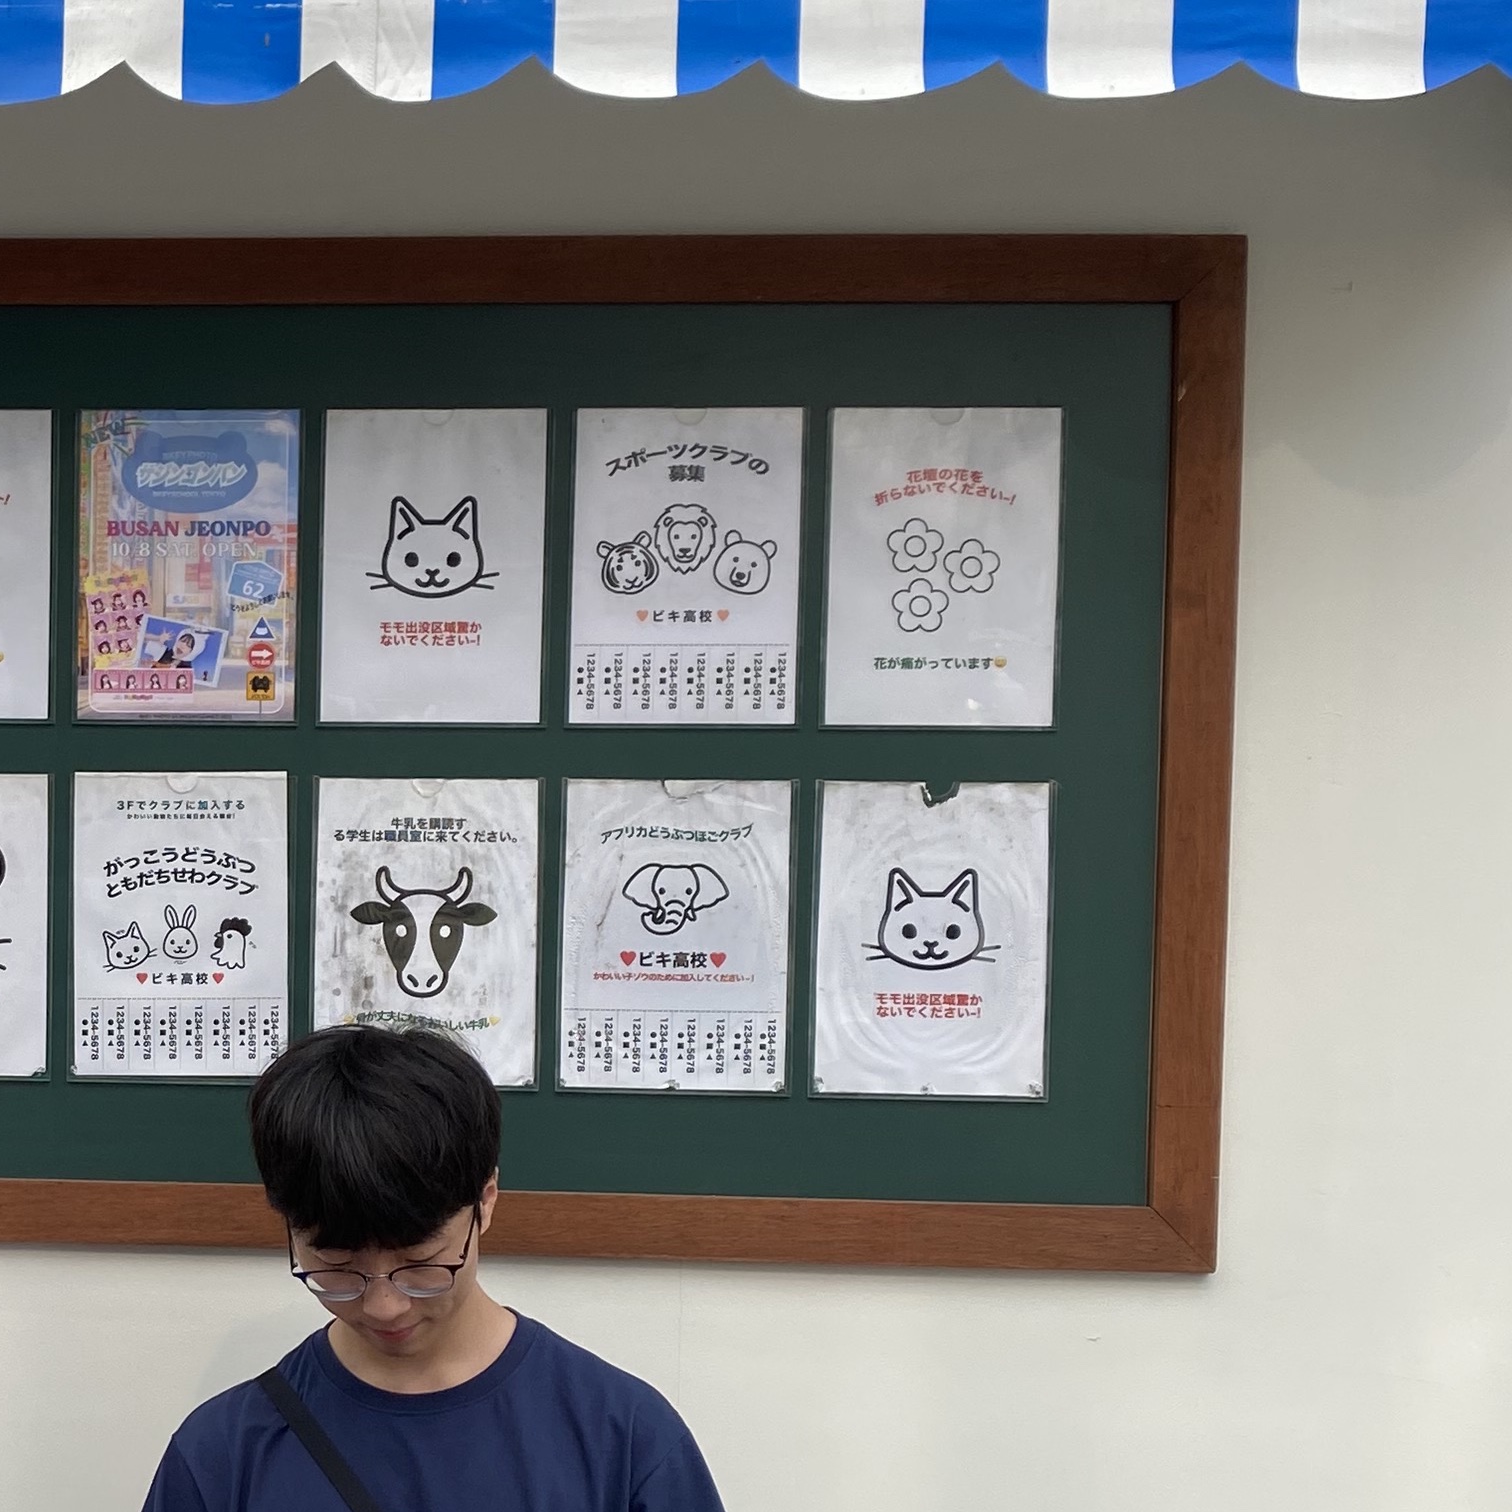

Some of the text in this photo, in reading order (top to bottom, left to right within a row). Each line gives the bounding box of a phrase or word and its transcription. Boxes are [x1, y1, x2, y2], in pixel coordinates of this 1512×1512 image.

[605, 443, 770, 477] スポーツクラブの
[668, 465, 705, 482] 募集
[906, 468, 984, 484] 花壇の花を
[107, 521, 271, 536] BUSAN JEONPO
[202, 542, 256, 557] OPEN
[243, 580, 265, 599] 62
[586, 652, 596, 710] 1234-5678
[613, 652, 623, 710] 1234-5678
[641, 652, 651, 710] 1234-5678
[668, 652, 678, 710] 1234-5678
[695, 652, 705, 710] 1234-5678
[725, 652, 735, 710] 1234-5678
[752, 652, 762, 710] 1234-5678
[776, 652, 786, 710] 1234-5678
[116, 799, 246, 811] 3Fでクラブに加入する
[600, 822, 755, 845] アフリカどうぶつほごクラブ
[103, 847, 257, 878] がっこうどうぶつ
[105, 867, 260, 899] ともだちせわクラブ
[90, 1005, 99, 1060] 1234-5678
[116, 1005, 125, 1060] 1234-5678
[142, 1005, 152, 1060] 1234-5678
[168, 1005, 177, 1060] 1234-5678
[194, 1005, 203, 1060] 1234-5678
[222, 1005, 231, 1060] 1234-5678
[248, 1005, 257, 1060] 1234-5678
[604, 1017, 614, 1072] 1234-5678
[632, 1018, 642, 1073] 1234-5678
[659, 1018, 668, 1073] 1234-5678
[686, 1018, 696, 1073] 1234-5678
[716, 1019, 725, 1074] 1234-5678
[743, 1019, 752, 1074] 1234-5678
[766, 1019, 776, 1074] 1234-5678
